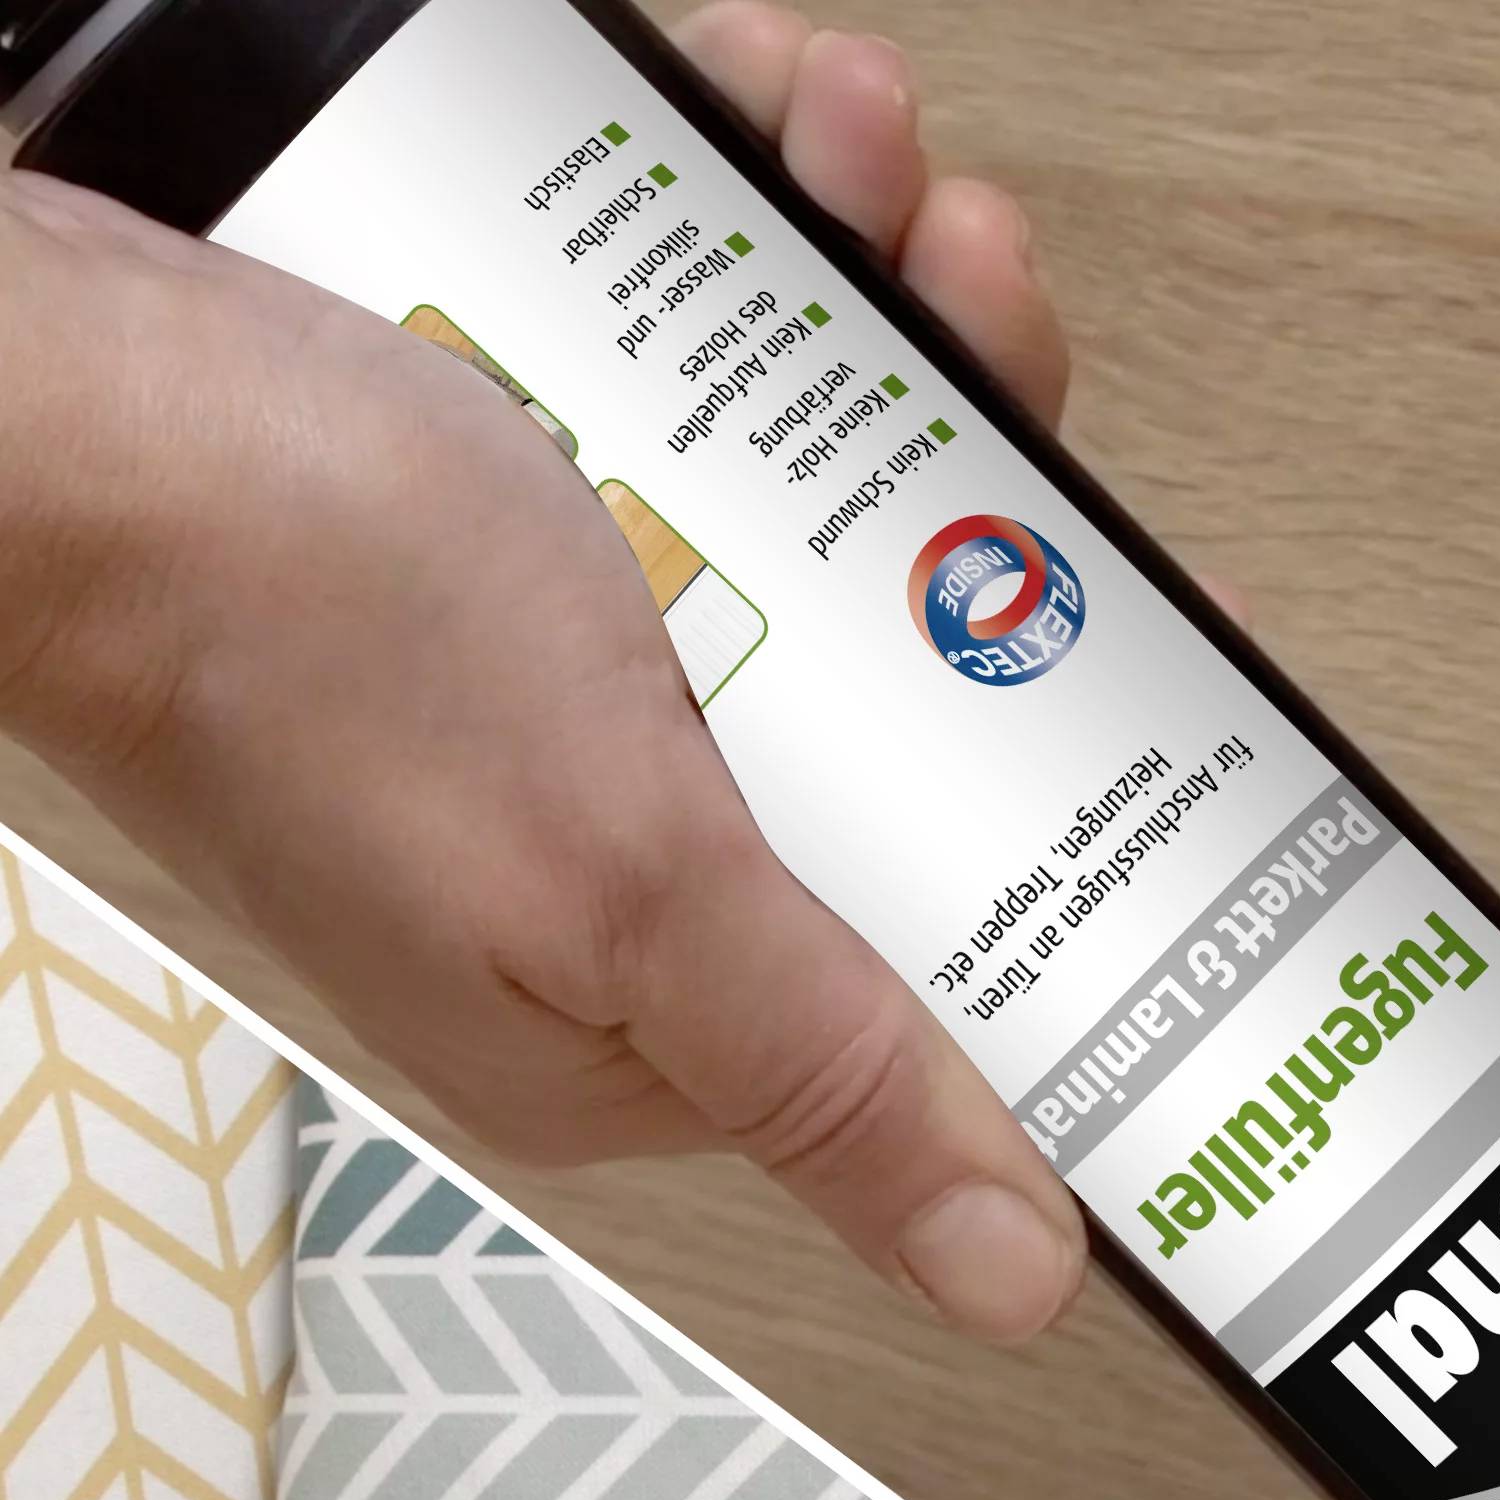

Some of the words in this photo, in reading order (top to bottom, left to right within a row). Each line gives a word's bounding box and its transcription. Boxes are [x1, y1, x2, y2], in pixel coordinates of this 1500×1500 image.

[524, 137, 610, 211] Elastisch
[561, 178, 656, 264] Schleifbar
[607, 219, 699, 310] silikonfrei
[658, 248, 736, 314] Wasser-
[616, 314, 657, 359] und
[738, 291, 778, 324] des
[761, 317, 812, 357] Kein
[679, 320, 747, 381] Holzes
[667, 353, 768, 454] Aufquellen
[749, 362, 856, 457] verfärbung
[828, 389, 890, 439] Keine
[788, 435, 838, 483] Holz-
[886, 433, 938, 474] Kein
[808, 470, 895, 561] Schwund
[938, 547, 1013, 616] INSIDE
[1213, 735, 1254, 773] für
[1050, 747, 1173, 859] Heizungen,
[1059, 764, 1219, 928] Anschlussfugen
[1213, 796, 1380, 959] Parkett
[970, 865, 1064, 954] Treppen
[1029, 925, 1065, 960] an
[929, 951, 975, 993] etc.
[963, 958, 1041, 1021] Türen,
[1187, 940, 1237, 991] &
[1137, 910, 1490, 1260] Fugenfüller
